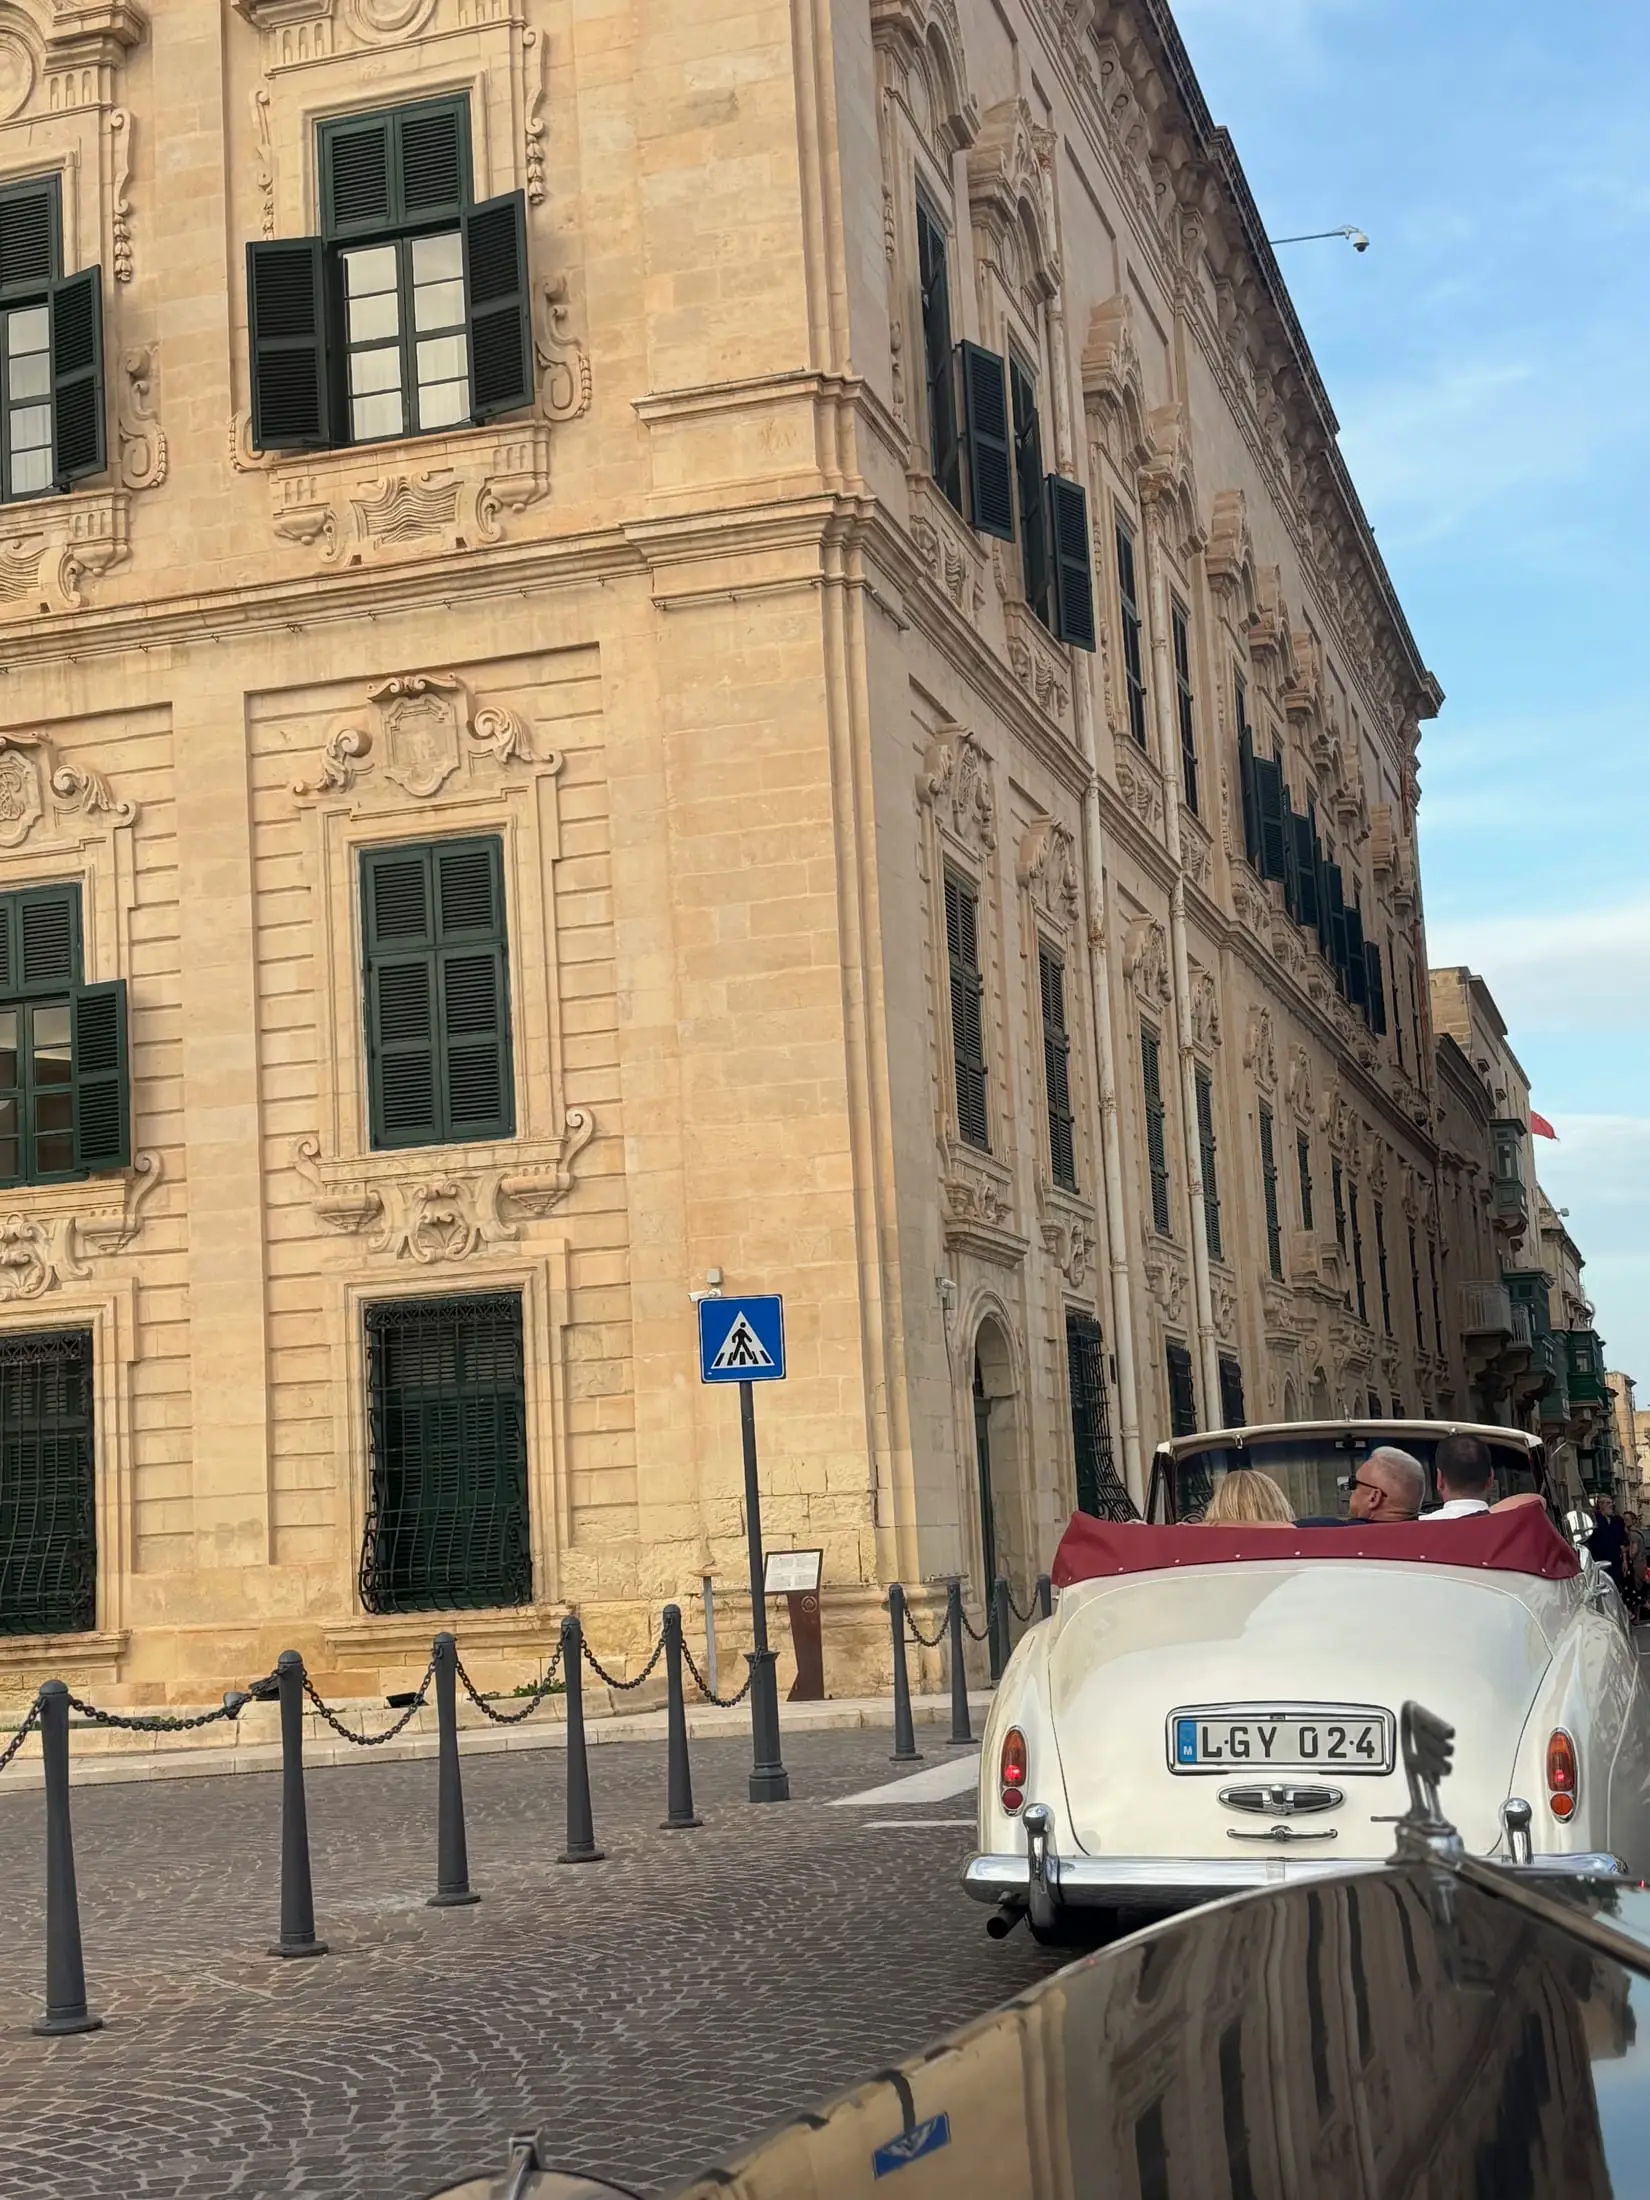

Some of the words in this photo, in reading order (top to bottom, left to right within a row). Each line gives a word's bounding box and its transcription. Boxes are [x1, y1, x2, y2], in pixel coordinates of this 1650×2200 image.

[1183, 1745, 1193, 1756] M
[1202, 1726, 1277, 1758] LGY
[1299, 1726, 1375, 1758] 024
